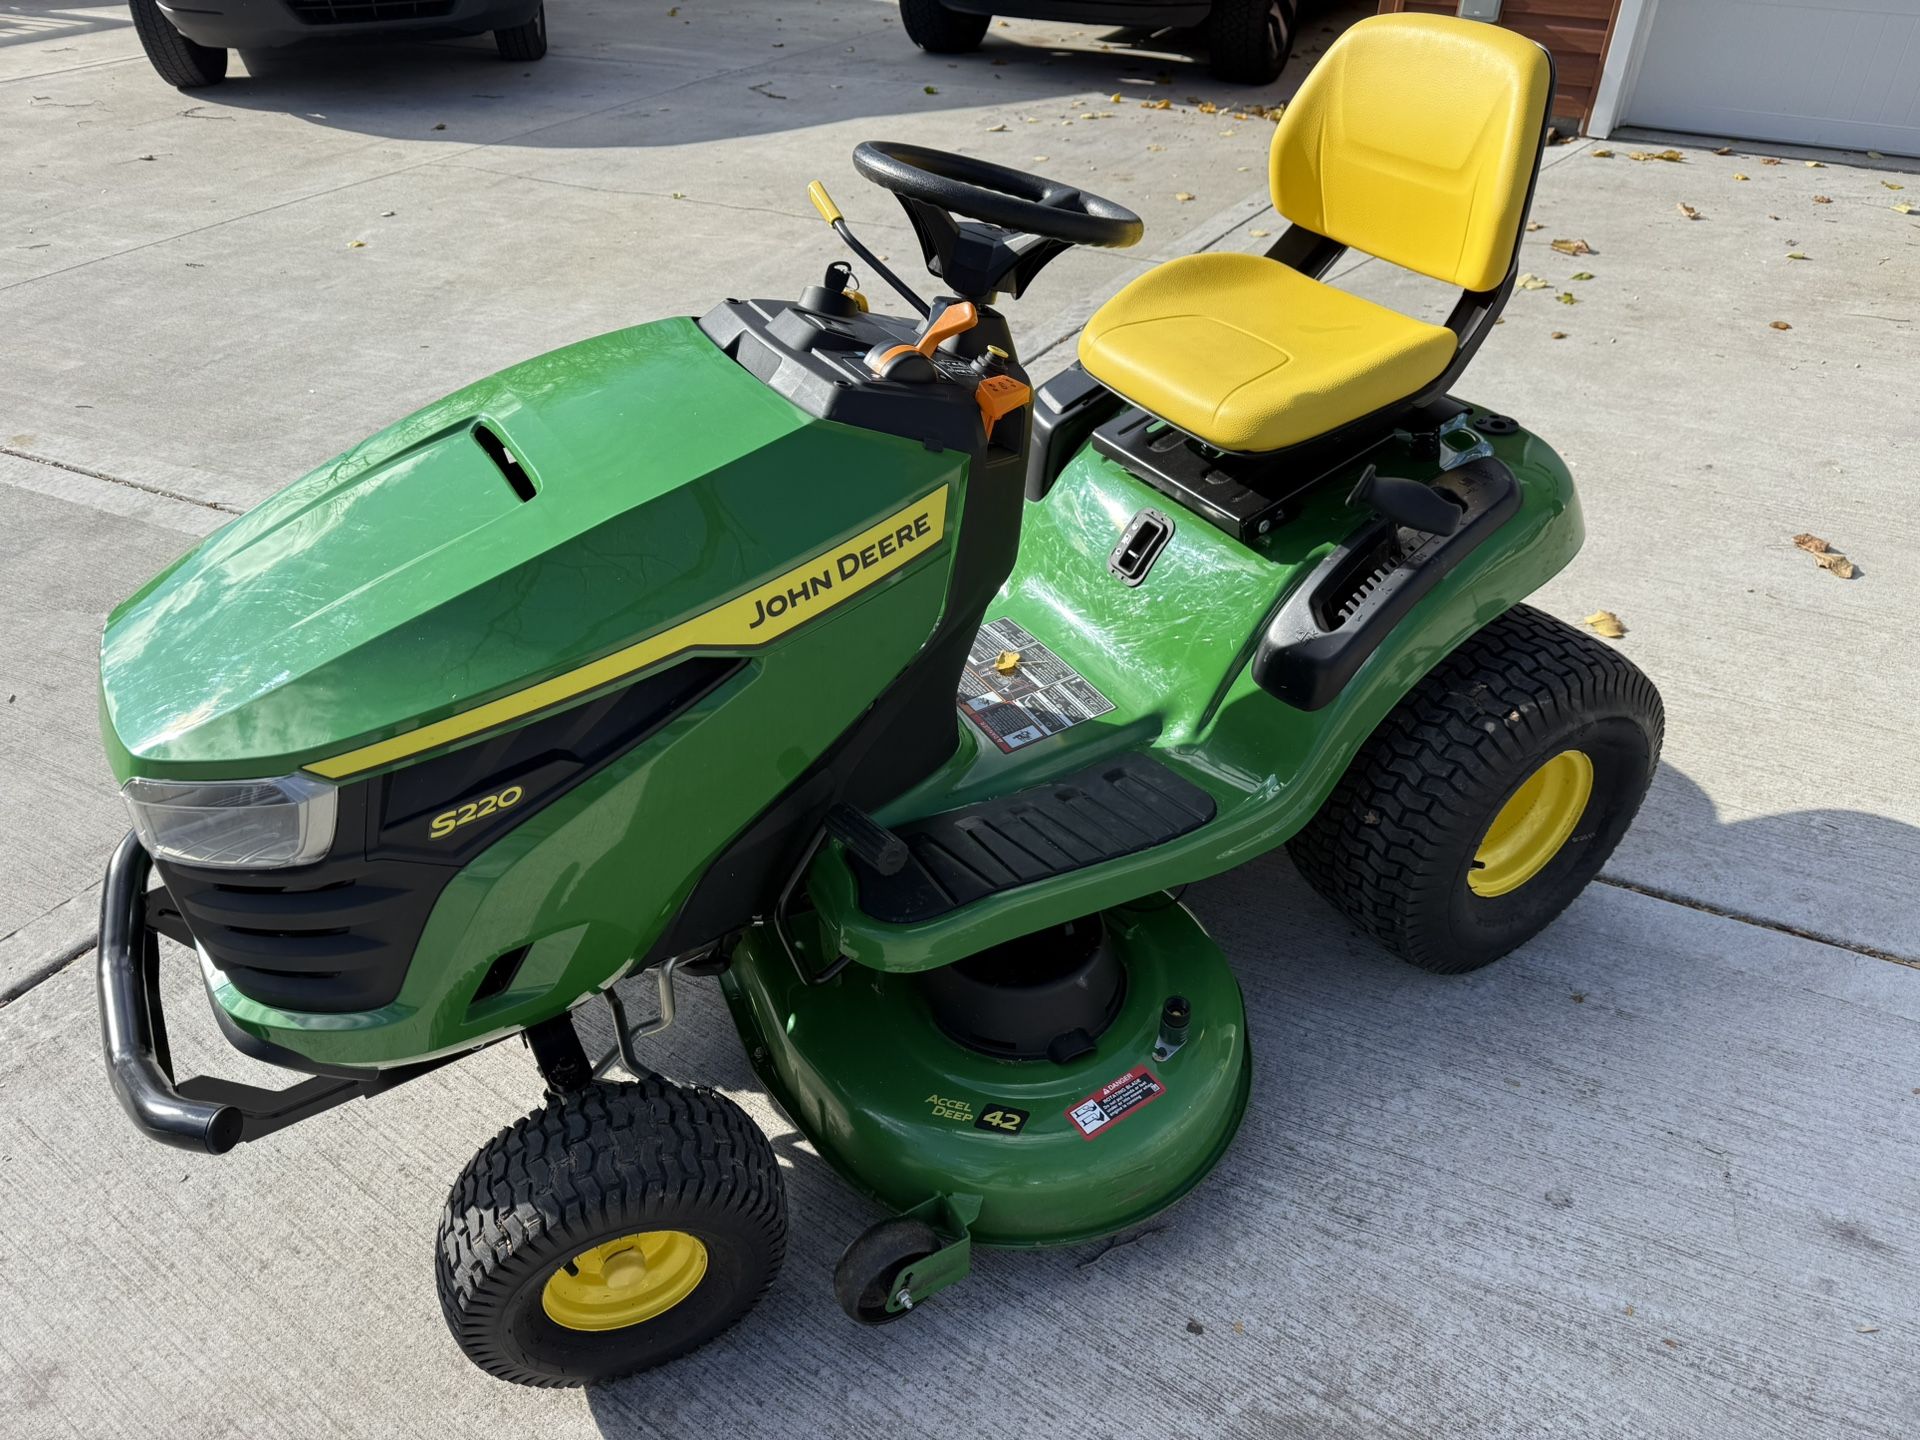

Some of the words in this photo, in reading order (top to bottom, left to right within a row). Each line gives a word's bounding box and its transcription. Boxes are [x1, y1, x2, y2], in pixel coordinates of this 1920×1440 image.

[750, 570, 832, 629] JOHN
[837, 512, 931, 581] DEERE
[431, 786, 522, 839] S220
[1108, 1073, 1134, 1090] DANGER
[925, 1094, 971, 1112] ACCEL
[1102, 1088, 1126, 1103] ROTATING
[932, 1105, 974, 1121] DEEP
[983, 1111, 1021, 1131] 42
